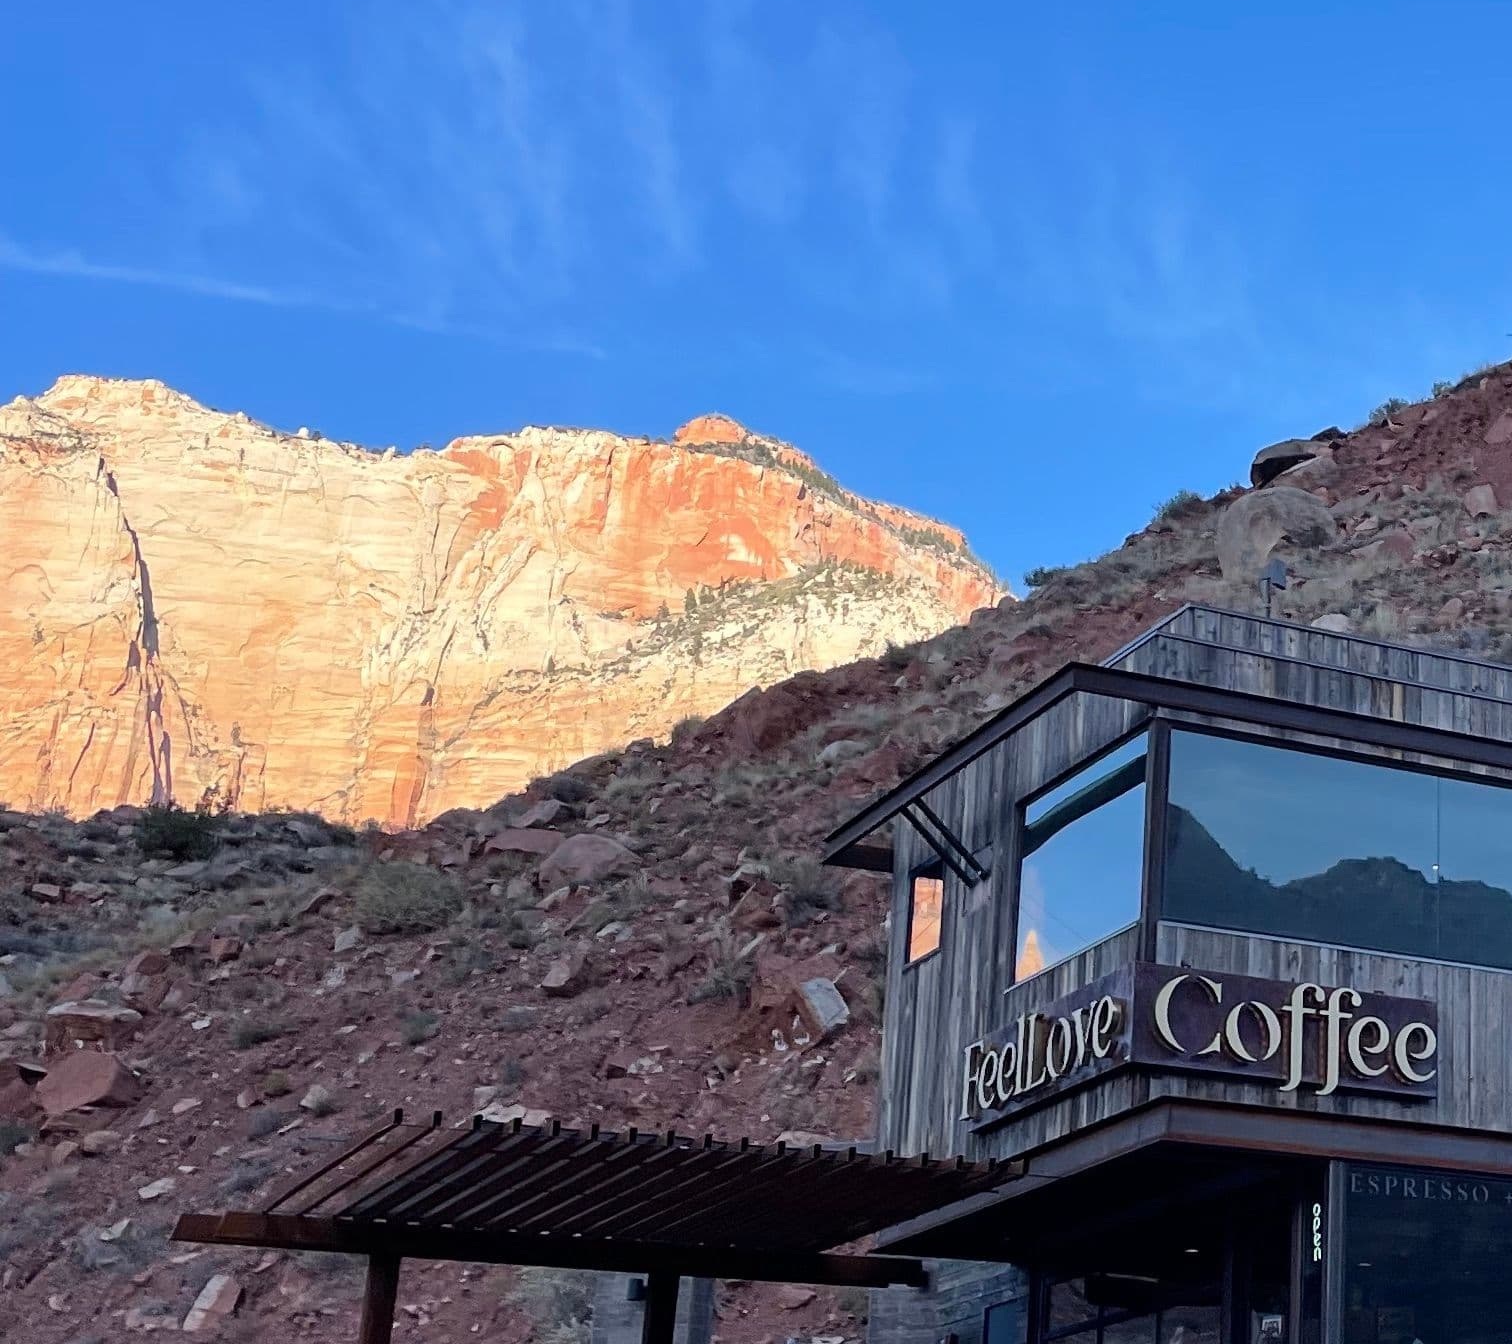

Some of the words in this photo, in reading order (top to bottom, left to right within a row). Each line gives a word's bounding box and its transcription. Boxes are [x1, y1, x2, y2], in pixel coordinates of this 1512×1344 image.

[959, 994, 1116, 1121] FeelLove
[1154, 974, 1437, 1096] Coffee
[1350, 1172, 1488, 1203] ESPRESSO
